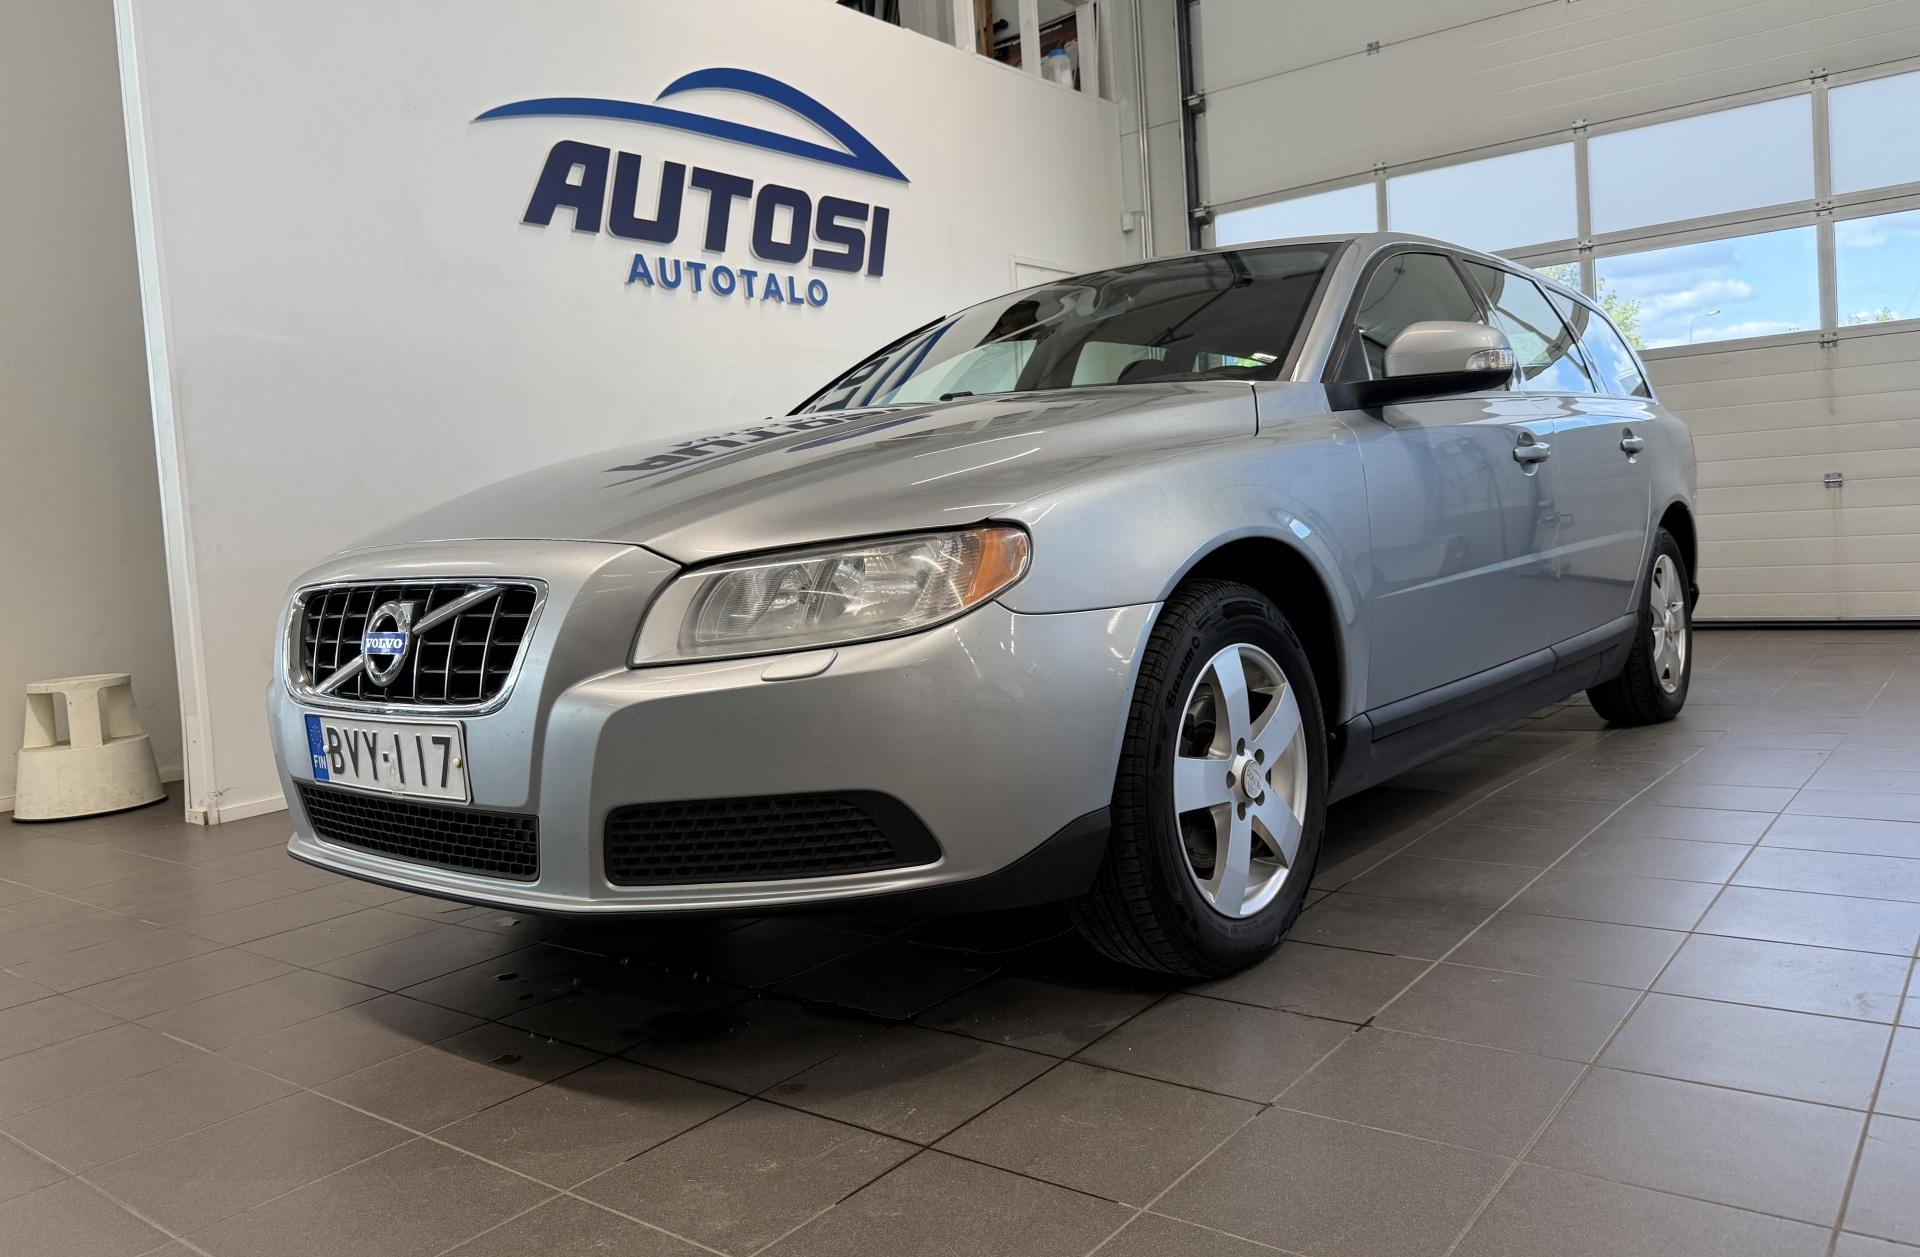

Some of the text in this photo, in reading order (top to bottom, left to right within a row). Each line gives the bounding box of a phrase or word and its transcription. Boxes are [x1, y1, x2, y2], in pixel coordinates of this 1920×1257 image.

[522, 140, 890, 277] AUTOSI
[626, 253, 829, 307] AUTOTALO
[366, 637, 402, 649] VOLVO
[313, 754, 327, 769] FIN
[327, 726, 452, 788] BVY-117
